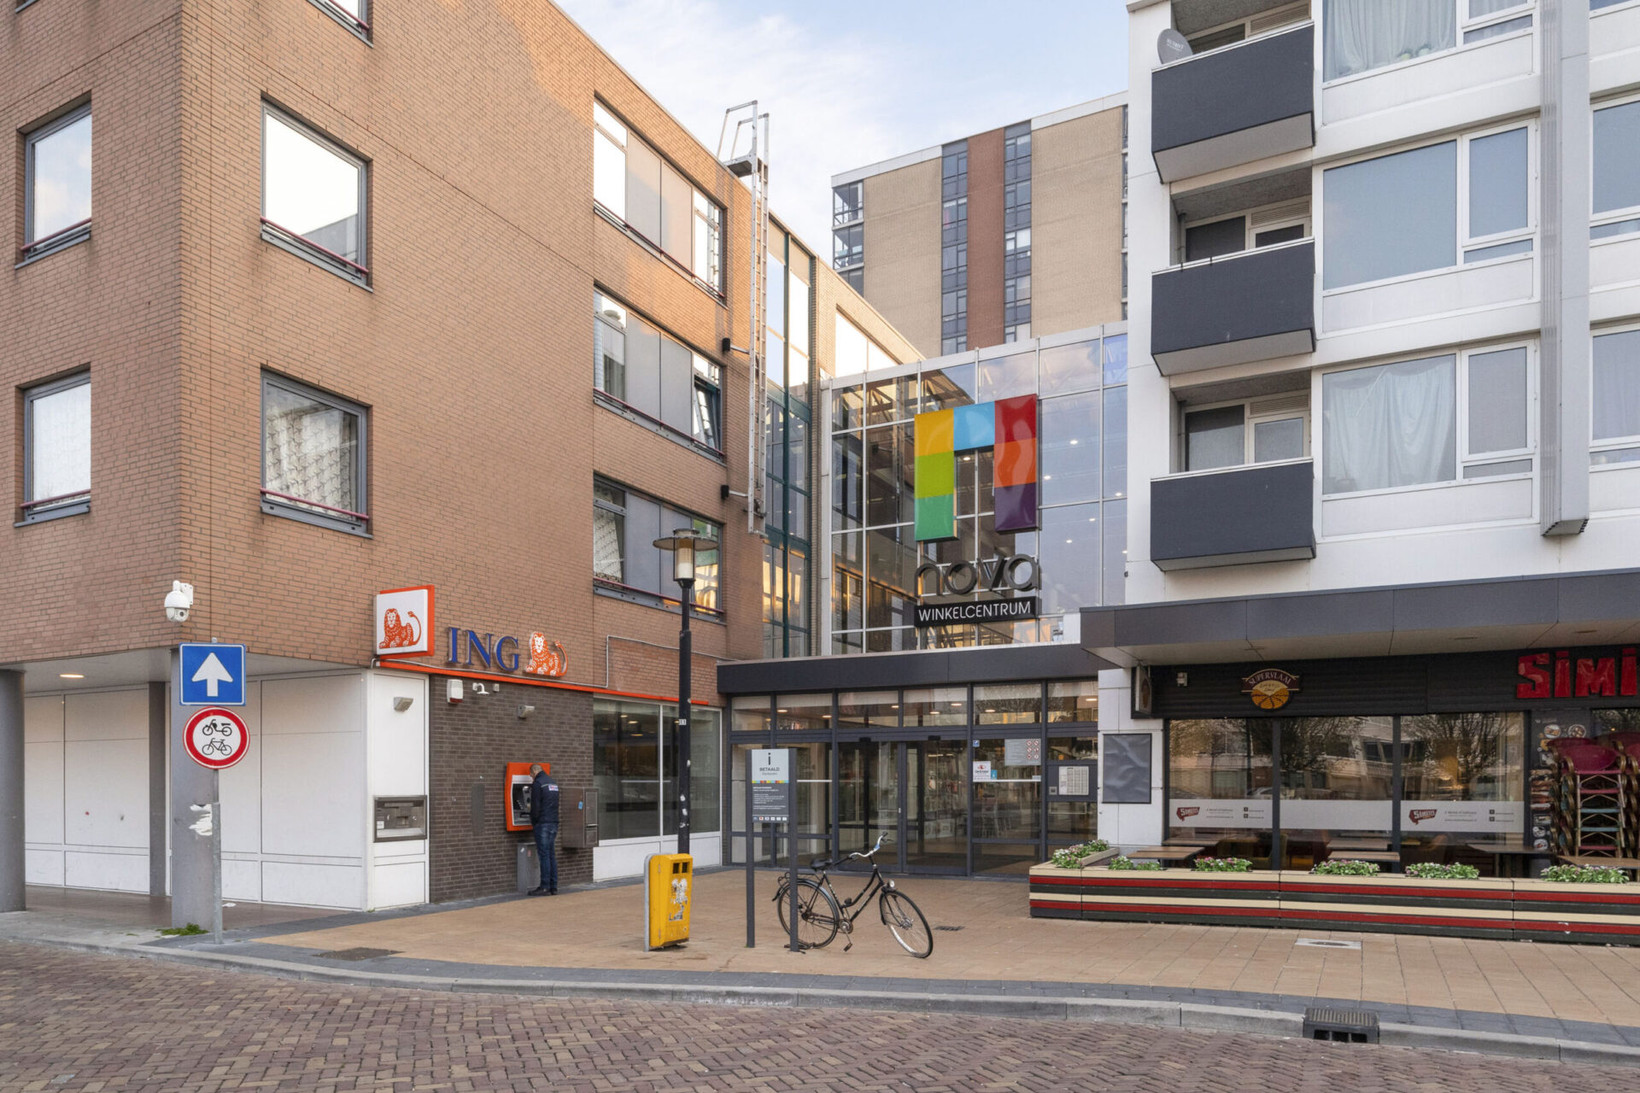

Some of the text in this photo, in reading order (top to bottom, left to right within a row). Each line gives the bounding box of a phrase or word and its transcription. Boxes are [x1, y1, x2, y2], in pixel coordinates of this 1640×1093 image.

[914, 553, 1041, 597] nova
[918, 601, 1031, 622] WINKELCENTRUM
[445, 626, 520, 672] ING
